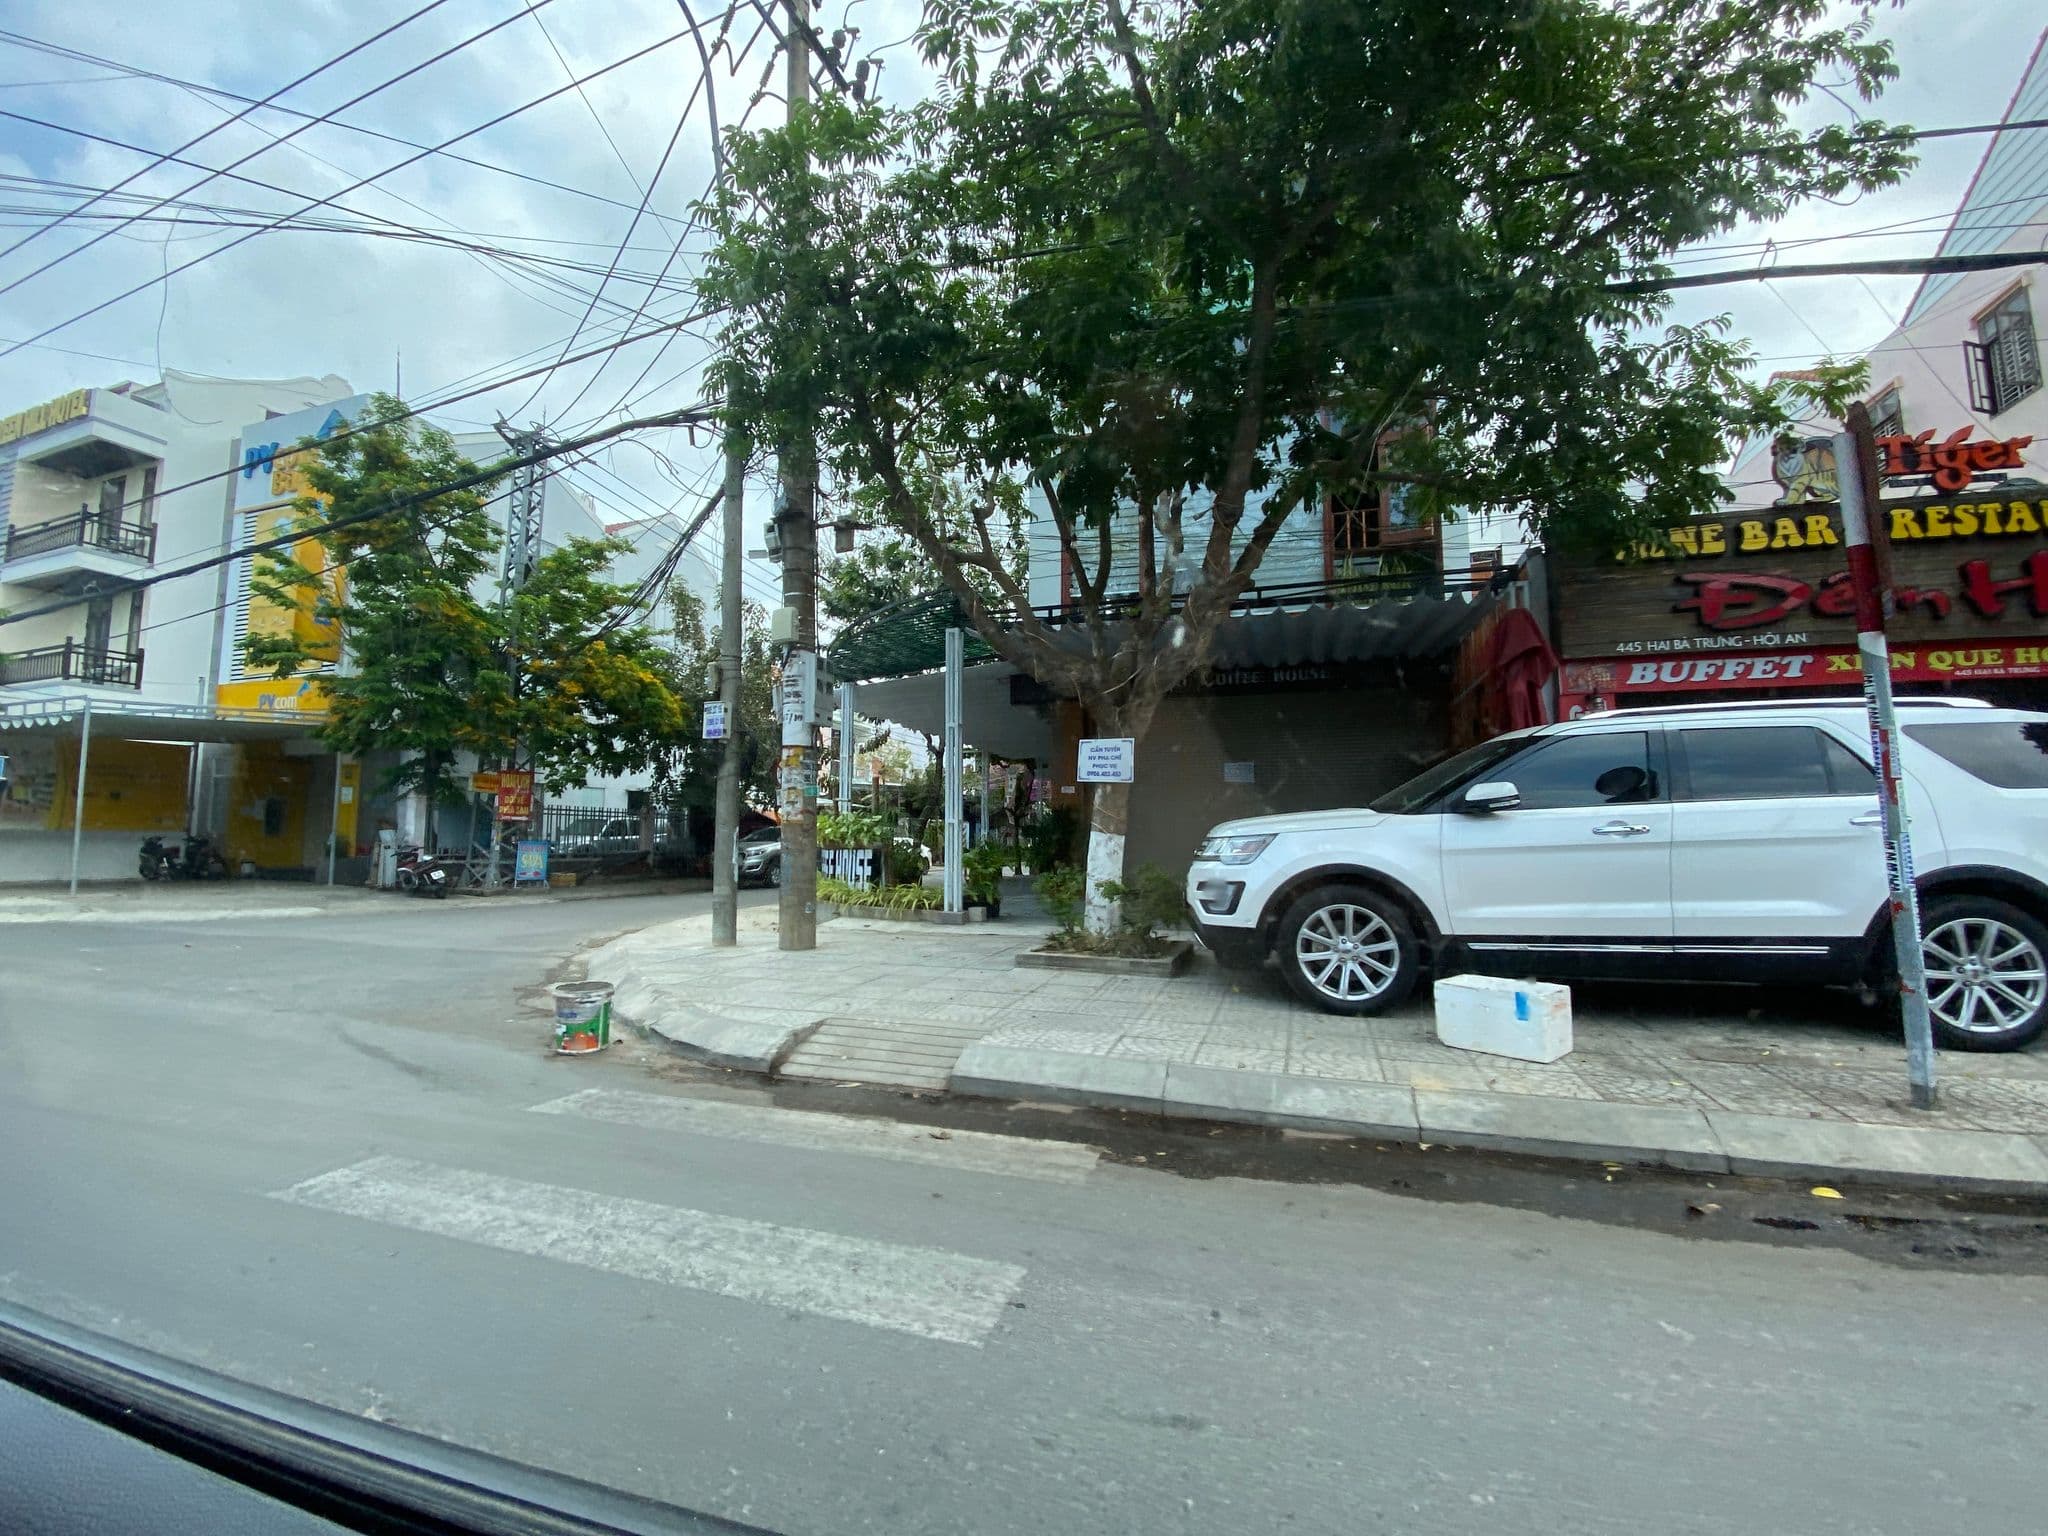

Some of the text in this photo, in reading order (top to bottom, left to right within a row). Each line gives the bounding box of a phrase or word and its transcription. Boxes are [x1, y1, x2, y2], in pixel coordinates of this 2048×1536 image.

[1875, 425, 2034, 490] Tiger
[1739, 514, 1839, 551] BAR
[1615, 641, 1642, 653] 445
[1647, 639, 1670, 651] HAI
[1785, 633, 1807, 644] AN
[1626, 655, 1814, 685] BUFFET
[1927, 648, 2005, 671] QUE
[259, 694, 297, 710] PVcom
[835, 849, 873, 892] HOUSE
